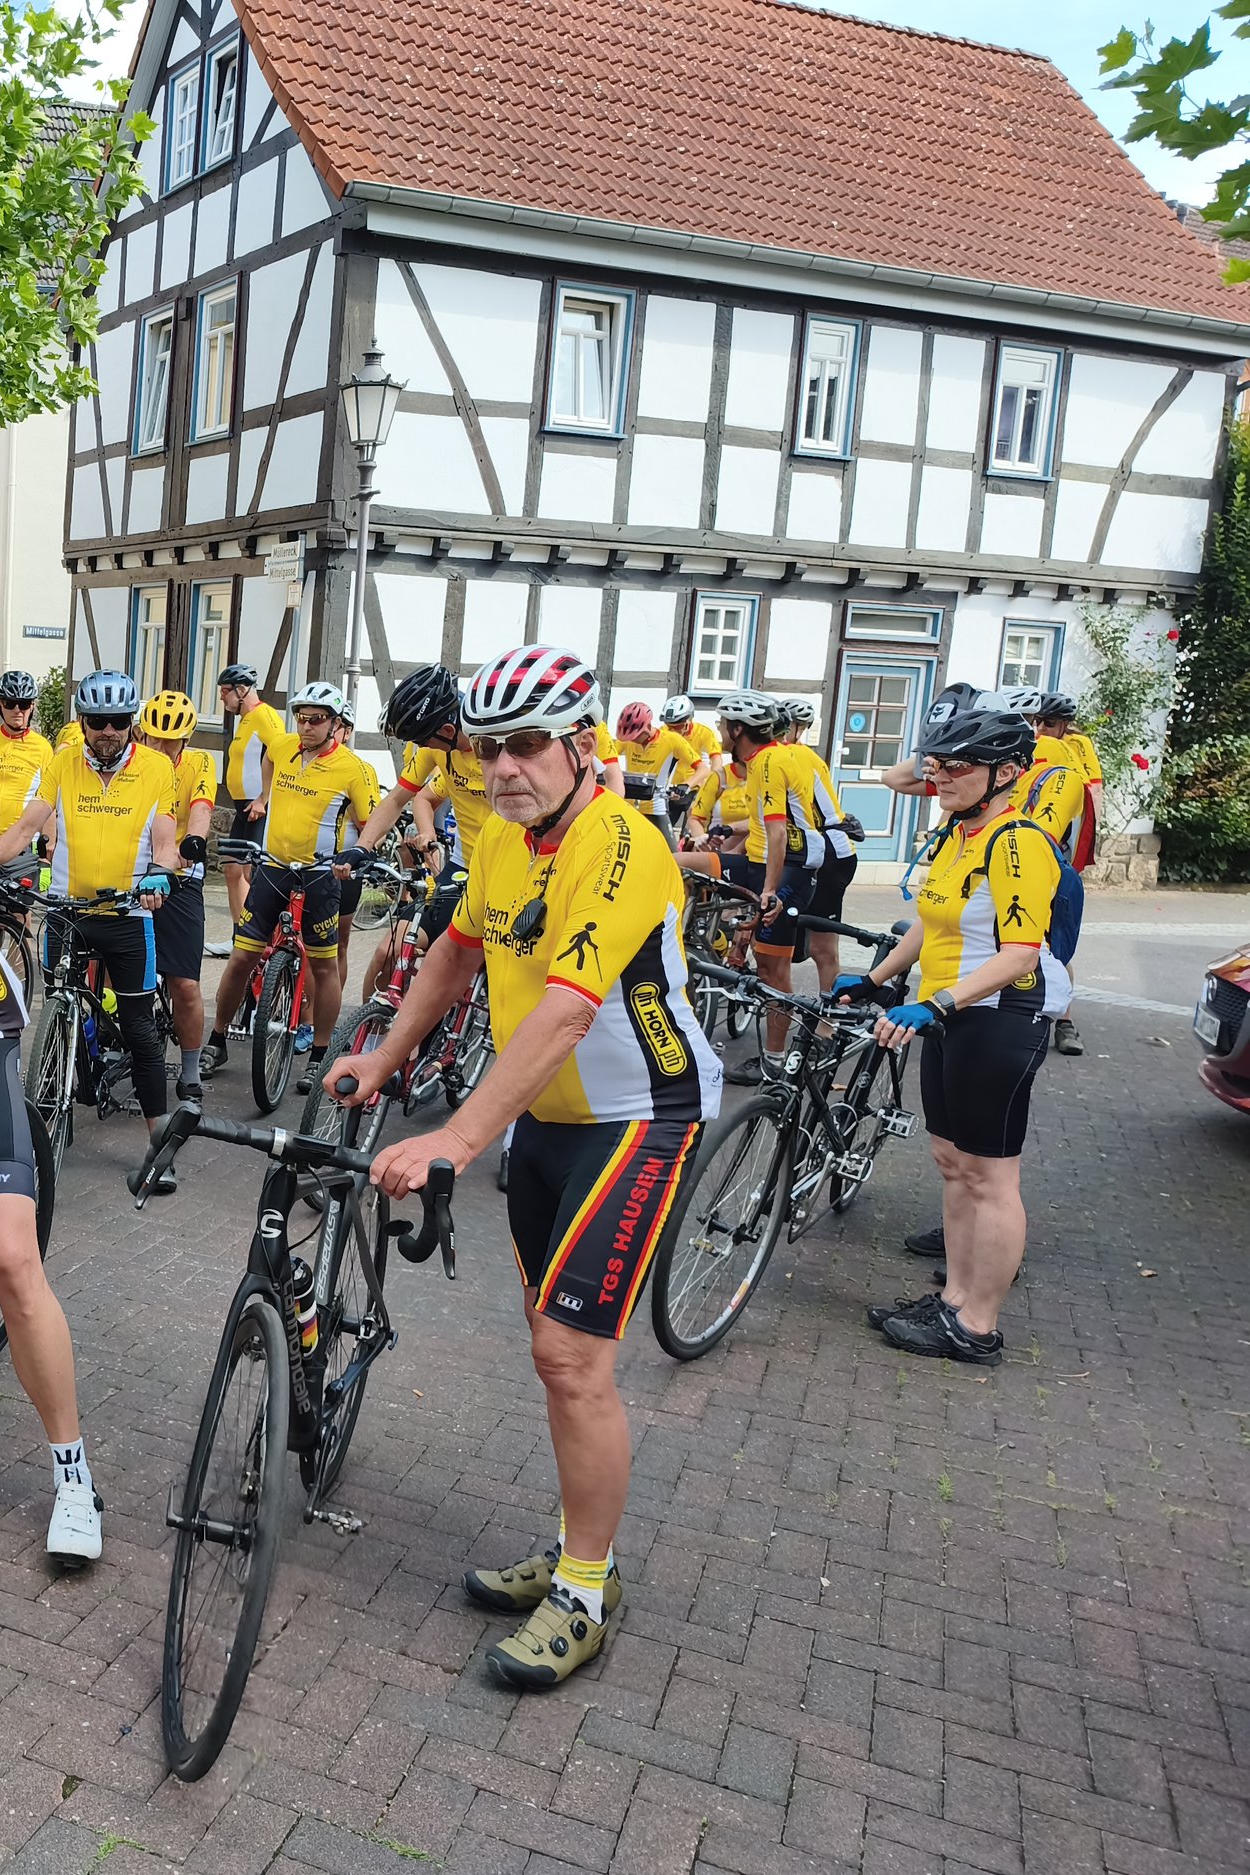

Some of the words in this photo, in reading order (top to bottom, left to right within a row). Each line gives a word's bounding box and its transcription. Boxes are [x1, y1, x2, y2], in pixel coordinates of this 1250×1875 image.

[25, 626, 65, 638] Mittelgasse
[276, 779, 319, 797] schwerger
[76, 803, 133, 817] schwerger
[592, 841, 617, 895] Sportswear
[602, 814, 632, 903] MAISCH
[643, 1009, 672, 1048] HORN
[598, 1257, 624, 1305] TGS
[612, 1156, 665, 1252] HAUSEN
